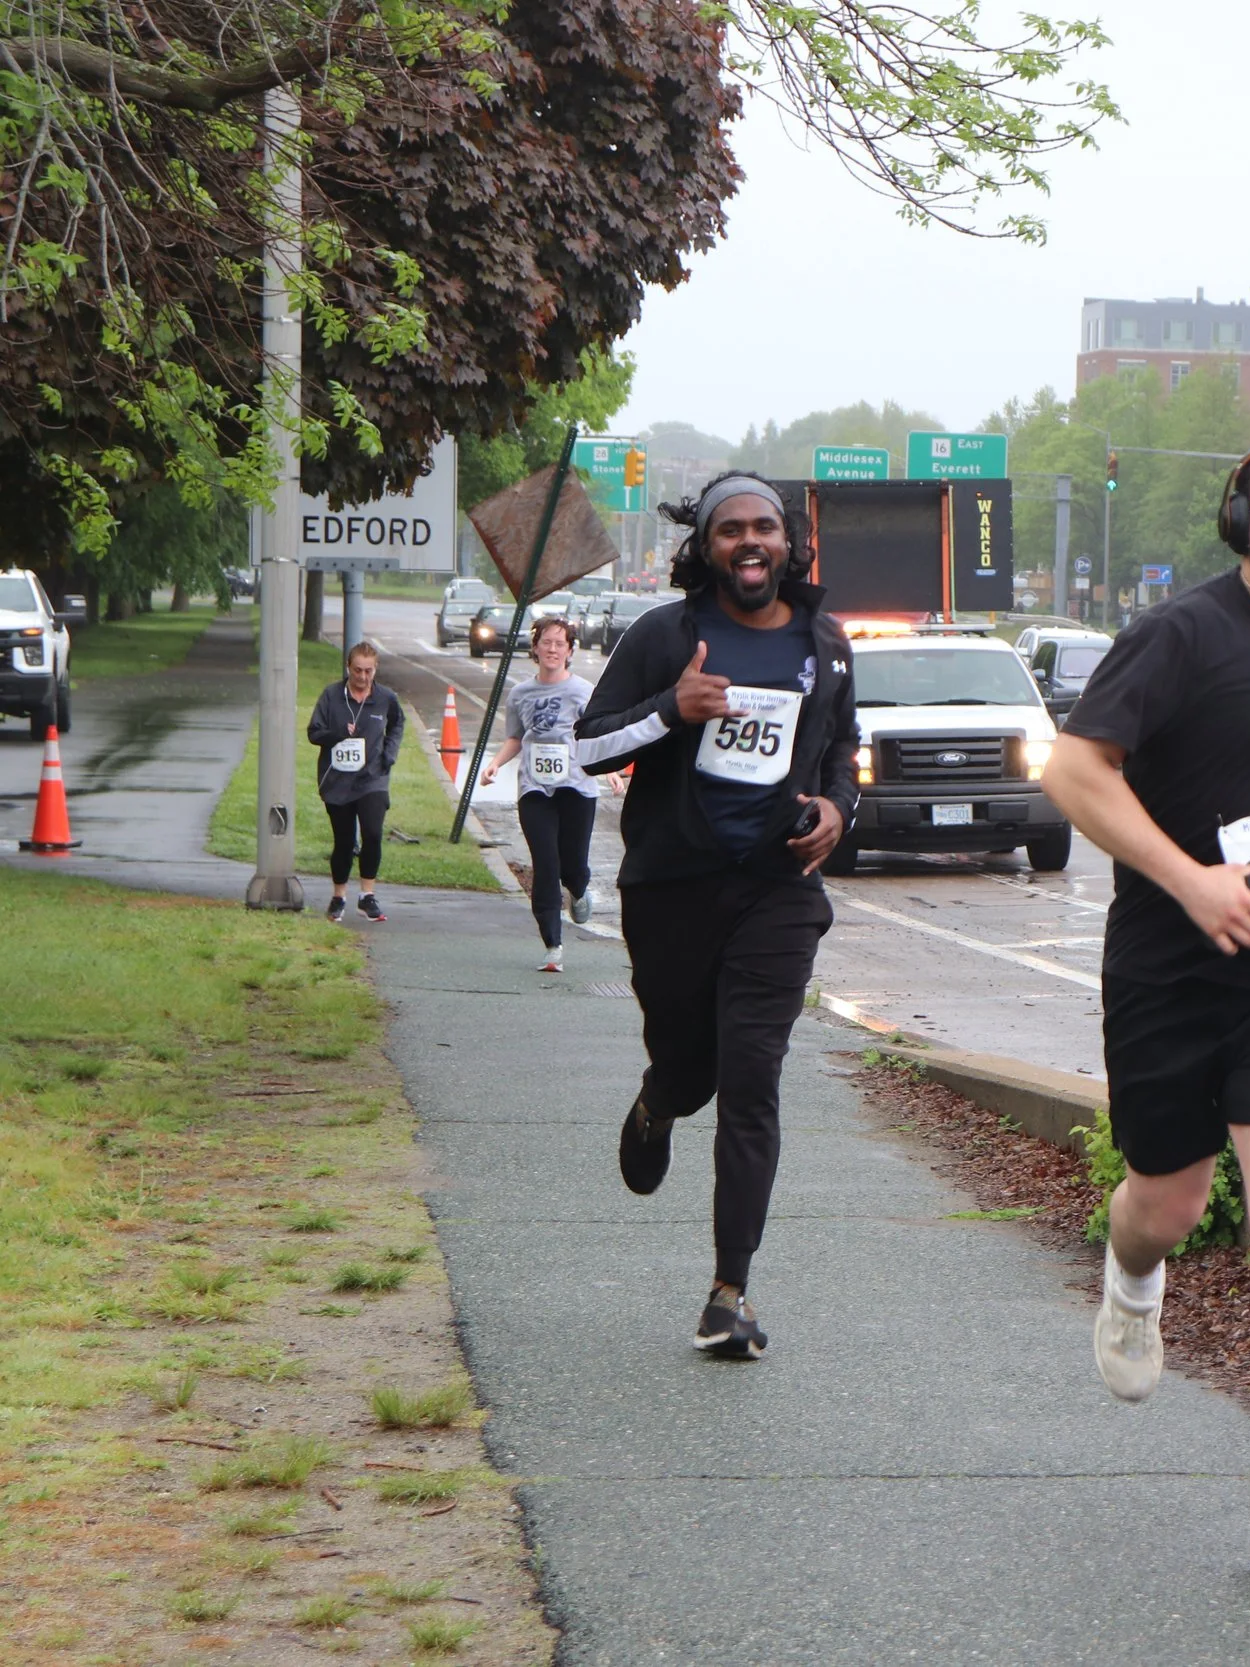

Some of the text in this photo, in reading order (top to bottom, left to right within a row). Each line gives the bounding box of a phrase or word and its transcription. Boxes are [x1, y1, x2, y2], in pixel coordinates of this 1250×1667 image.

[595, 449, 607, 459] 28
[935, 442, 948, 454] 16
[819, 452, 882, 465] Middlesex
[592, 465, 626, 474] Stoneh
[827, 467, 875, 480] Avenue
[932, 463, 982, 475] Everett
[302, 516, 431, 546] EDFORD
[977, 500, 993, 567] WANCO
[715, 716, 784, 757] 595
[335, 750, 361, 762] 915
[535, 757, 563, 774] 536
